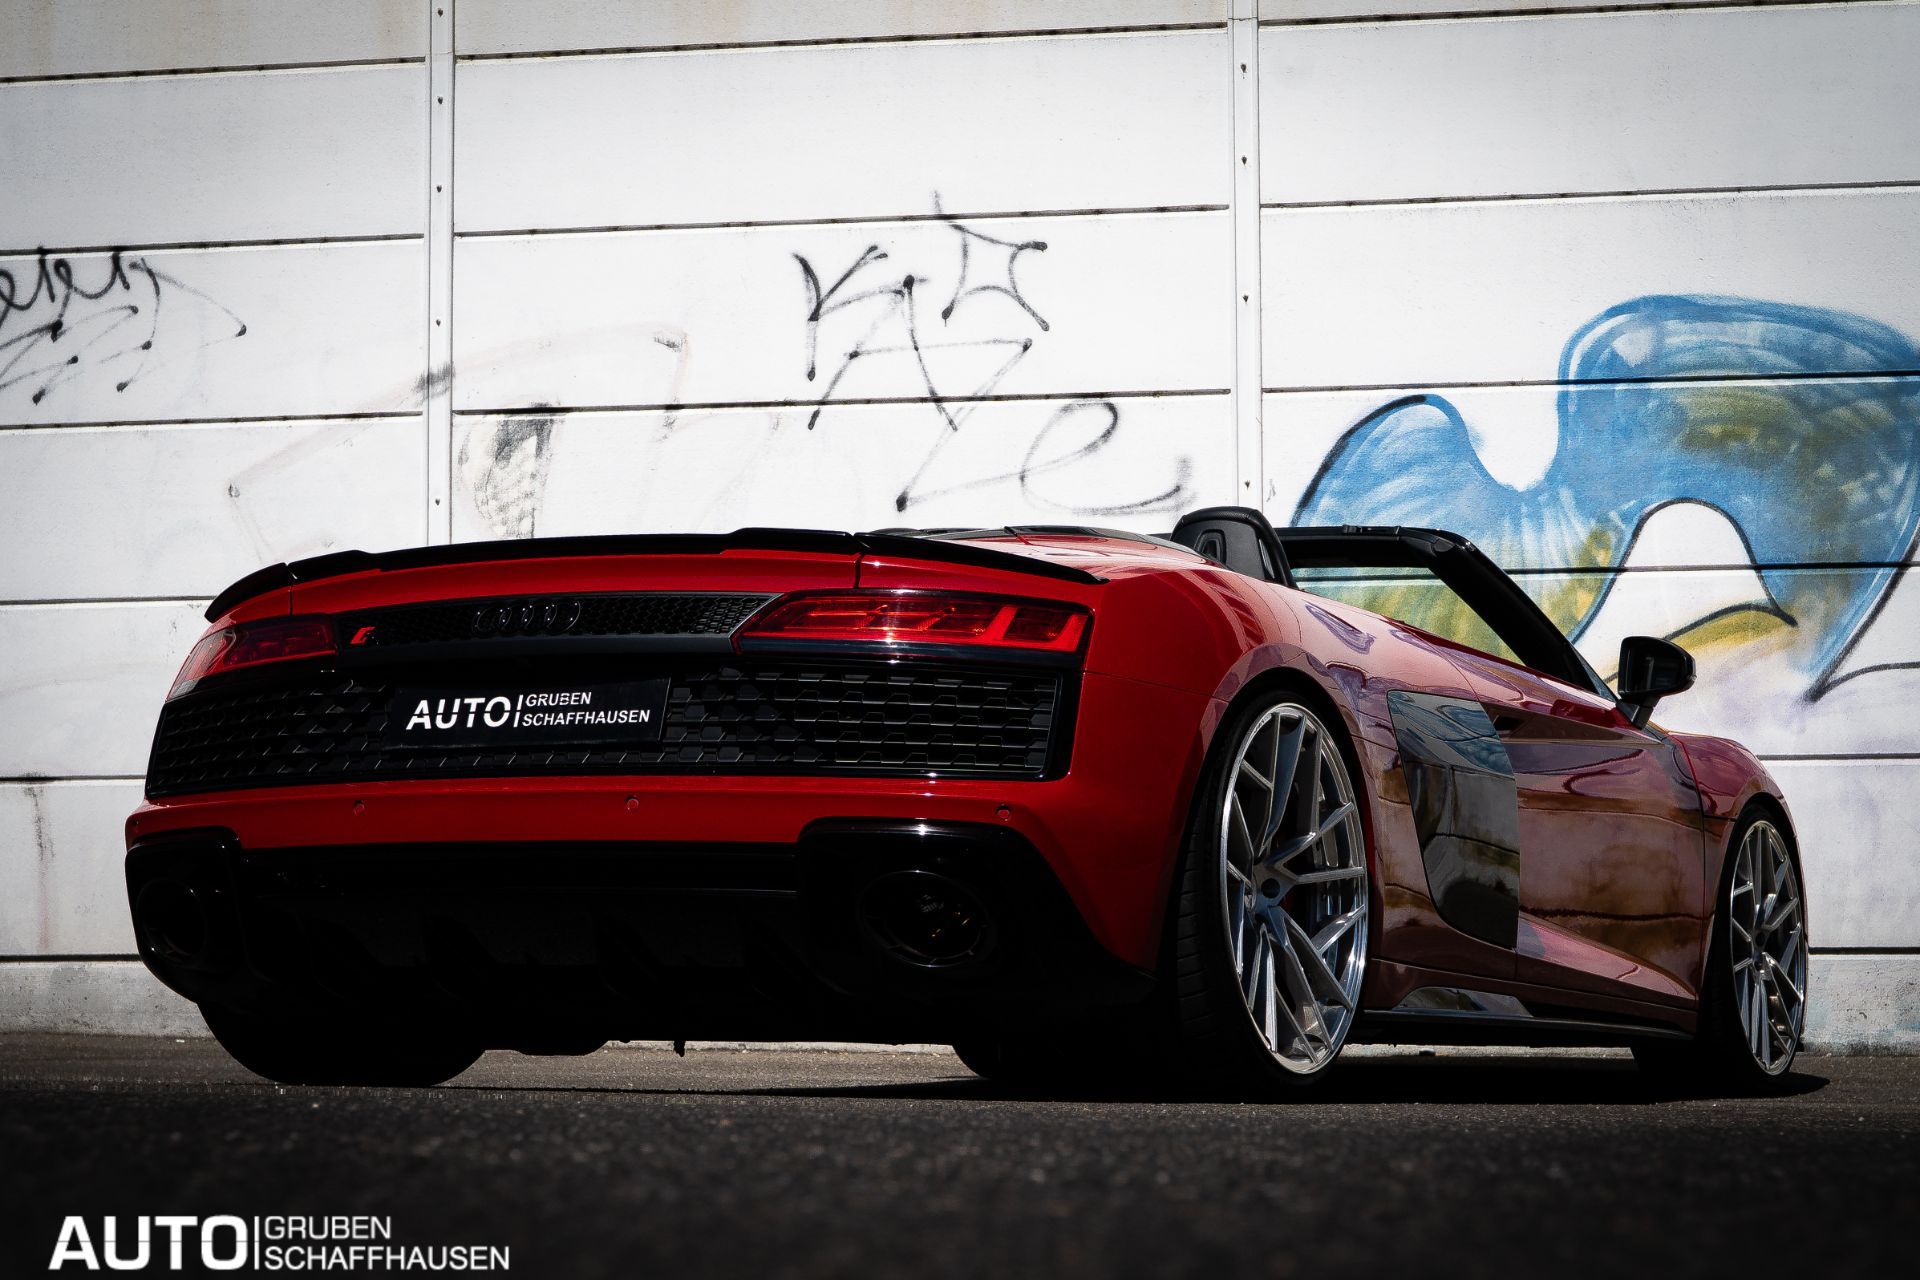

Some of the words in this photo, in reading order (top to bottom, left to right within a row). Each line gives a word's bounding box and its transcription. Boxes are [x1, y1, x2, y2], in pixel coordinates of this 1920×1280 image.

[525, 692, 592, 708] GRUBEN
[405, 696, 512, 731] AUTO
[522, 709, 651, 728] SCHAFFHAUSEN
